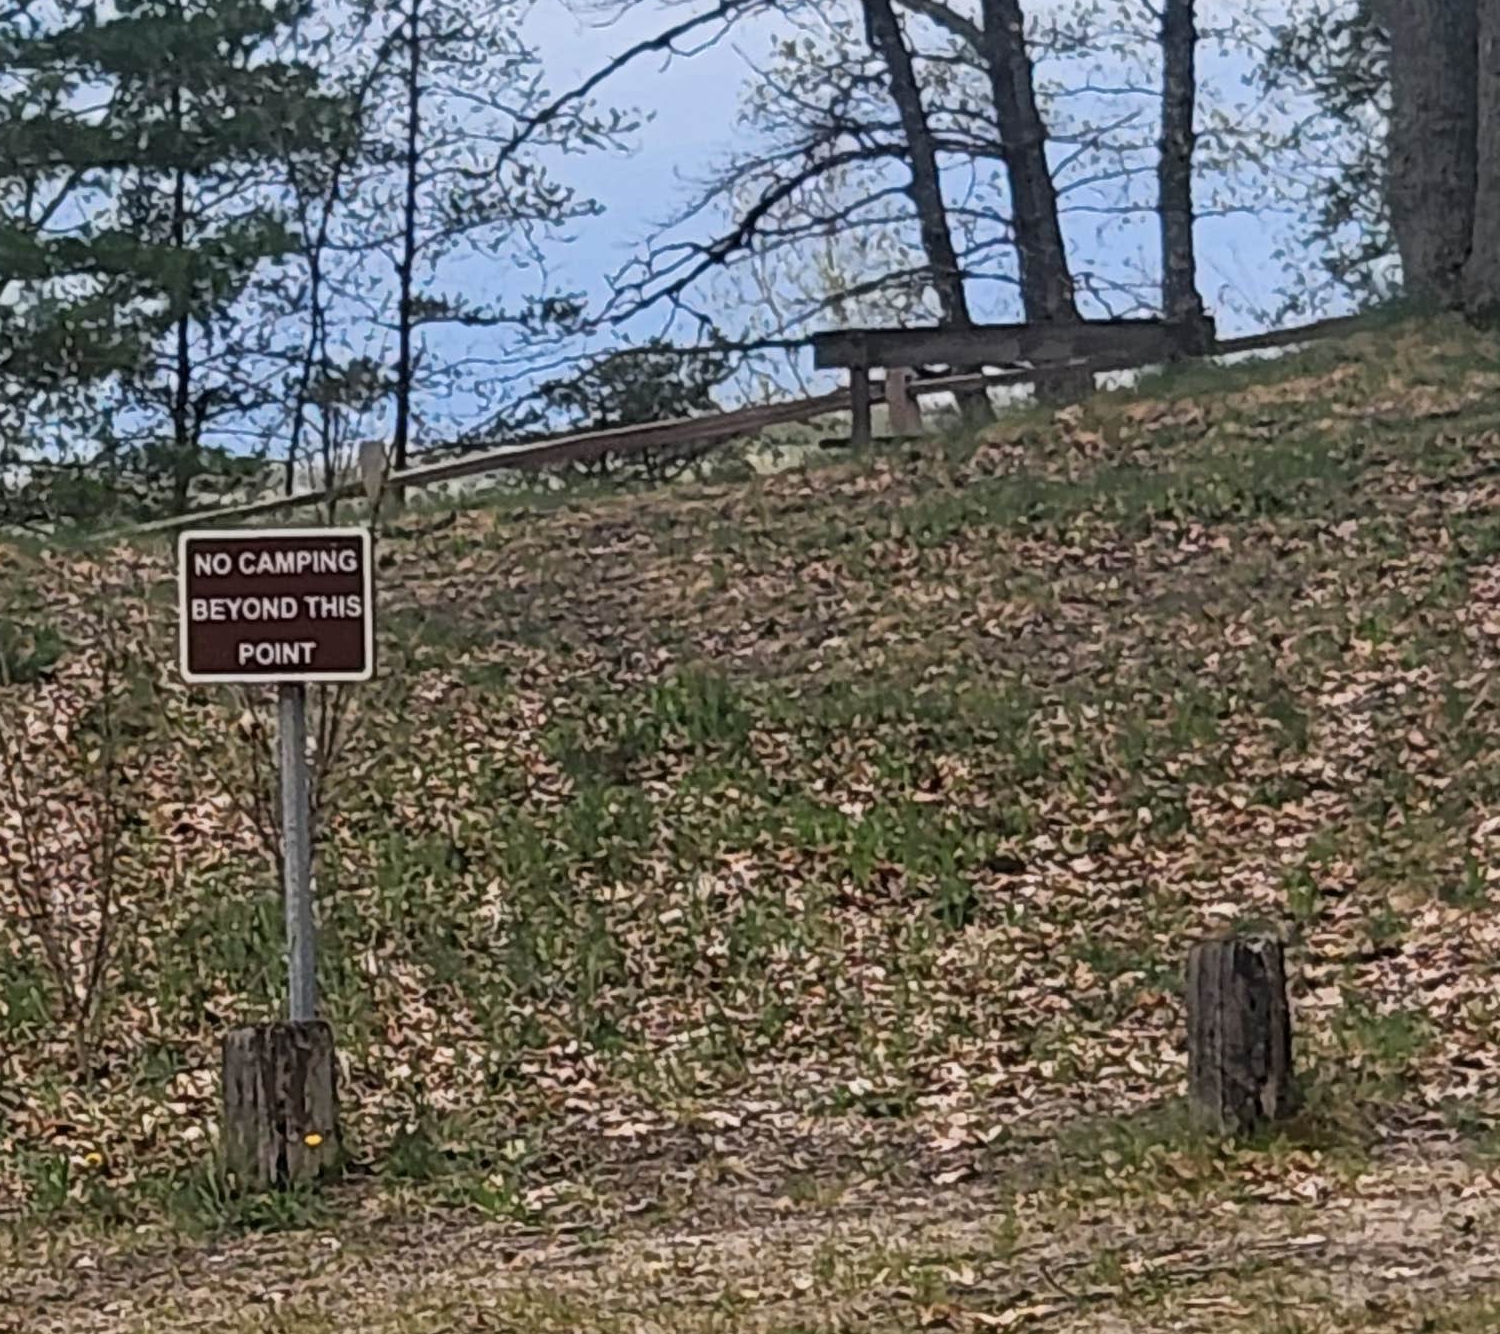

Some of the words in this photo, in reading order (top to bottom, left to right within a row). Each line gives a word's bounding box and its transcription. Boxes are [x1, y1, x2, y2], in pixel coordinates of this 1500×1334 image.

[194, 553, 232, 576] NO
[238, 549, 358, 575] CAMPING
[191, 596, 298, 621] BEYOND
[303, 595, 362, 618] THIS
[238, 641, 317, 665] POINT
